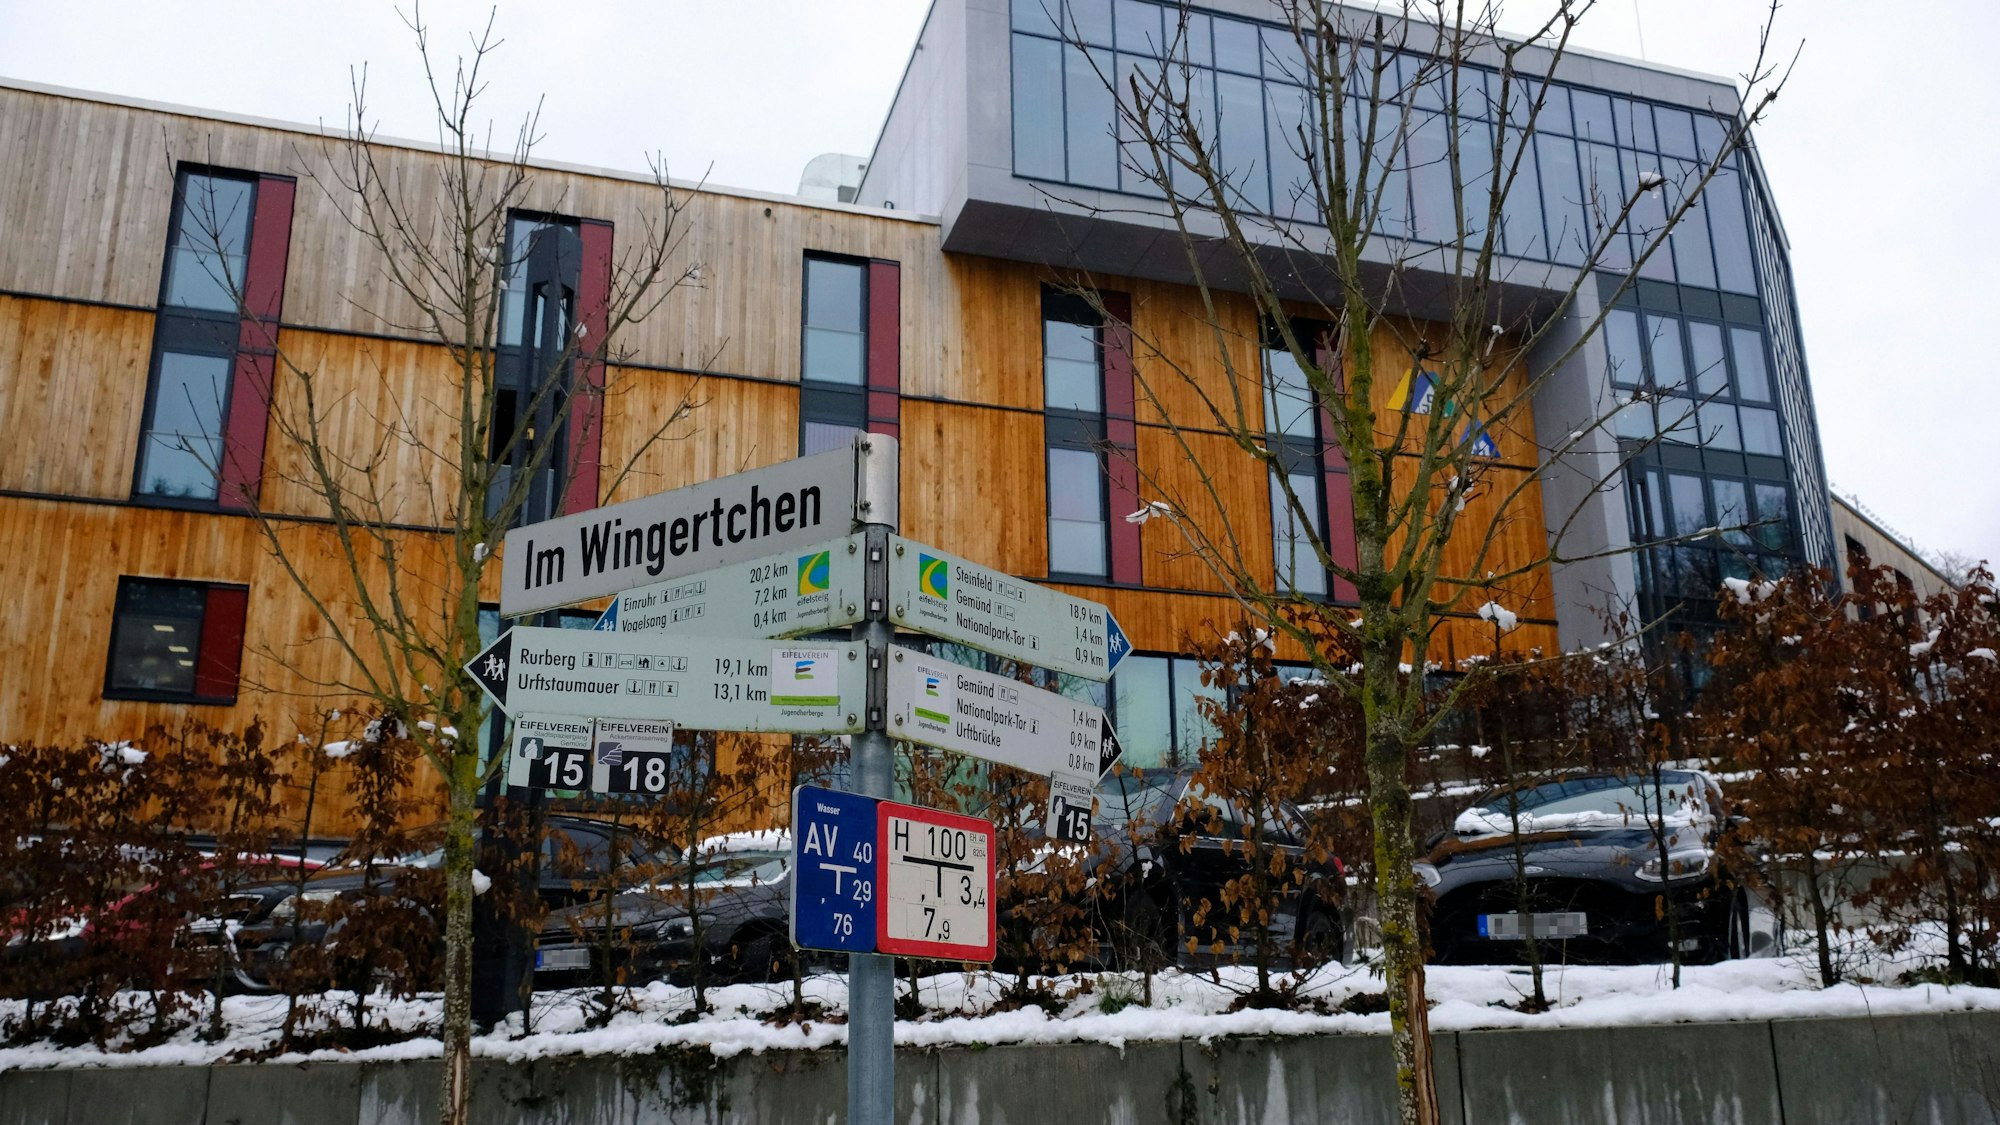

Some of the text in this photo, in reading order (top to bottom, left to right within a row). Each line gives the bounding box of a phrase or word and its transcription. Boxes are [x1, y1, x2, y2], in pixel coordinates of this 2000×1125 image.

[525, 484, 820, 590] Im Wingertchen
[624, 564, 788, 611] Einruhr 20,2 km
[797, 592, 829, 606] eifelsteig
[919, 595, 947, 612] eifelsteig
[956, 567, 1102, 625] Steinfeld 18,9 km
[622, 587, 787, 632] Vogelsang 7,2 km
[754, 609, 786, 629] 0,4 km
[956, 590, 1102, 646] Gemünd 1,4 km
[782, 651, 828, 659] EIFELVEREIN
[956, 612, 1103, 667] Nationalpark-Tor 0,9 km
[520, 648, 768, 678] Rurberg 19,1 km
[918, 665, 948, 680] EIFELVEREIN
[518, 673, 767, 702] Urftstaumauer 13,1 km
[957, 674, 1097, 730] Gemünd 1,4 km
[520, 721, 589, 734] EIFELVEREIN
[601, 723, 669, 733] EIFELVEREIN
[781, 709, 823, 718] Jugendherberge
[957, 698, 1026, 731] Nationalpark-Tor
[1070, 731, 1082, 748] 0,9
[1084, 736, 1096, 751] km
[957, 722, 1094, 772] Urftbrücke 0,8 km
[544, 752, 584, 786] 15
[624, 757, 666, 792] 18
[1054, 781, 1091, 795] EIFELVEREIN
[817, 802, 840, 815] Wasser
[1066, 810, 1088, 840] 15
[804, 822, 838, 857] AV
[853, 842, 872, 864] 40
[895, 820, 966, 860] H 100
[960, 876, 985, 909] 3,4
[924, 908, 950, 941] 7,9
